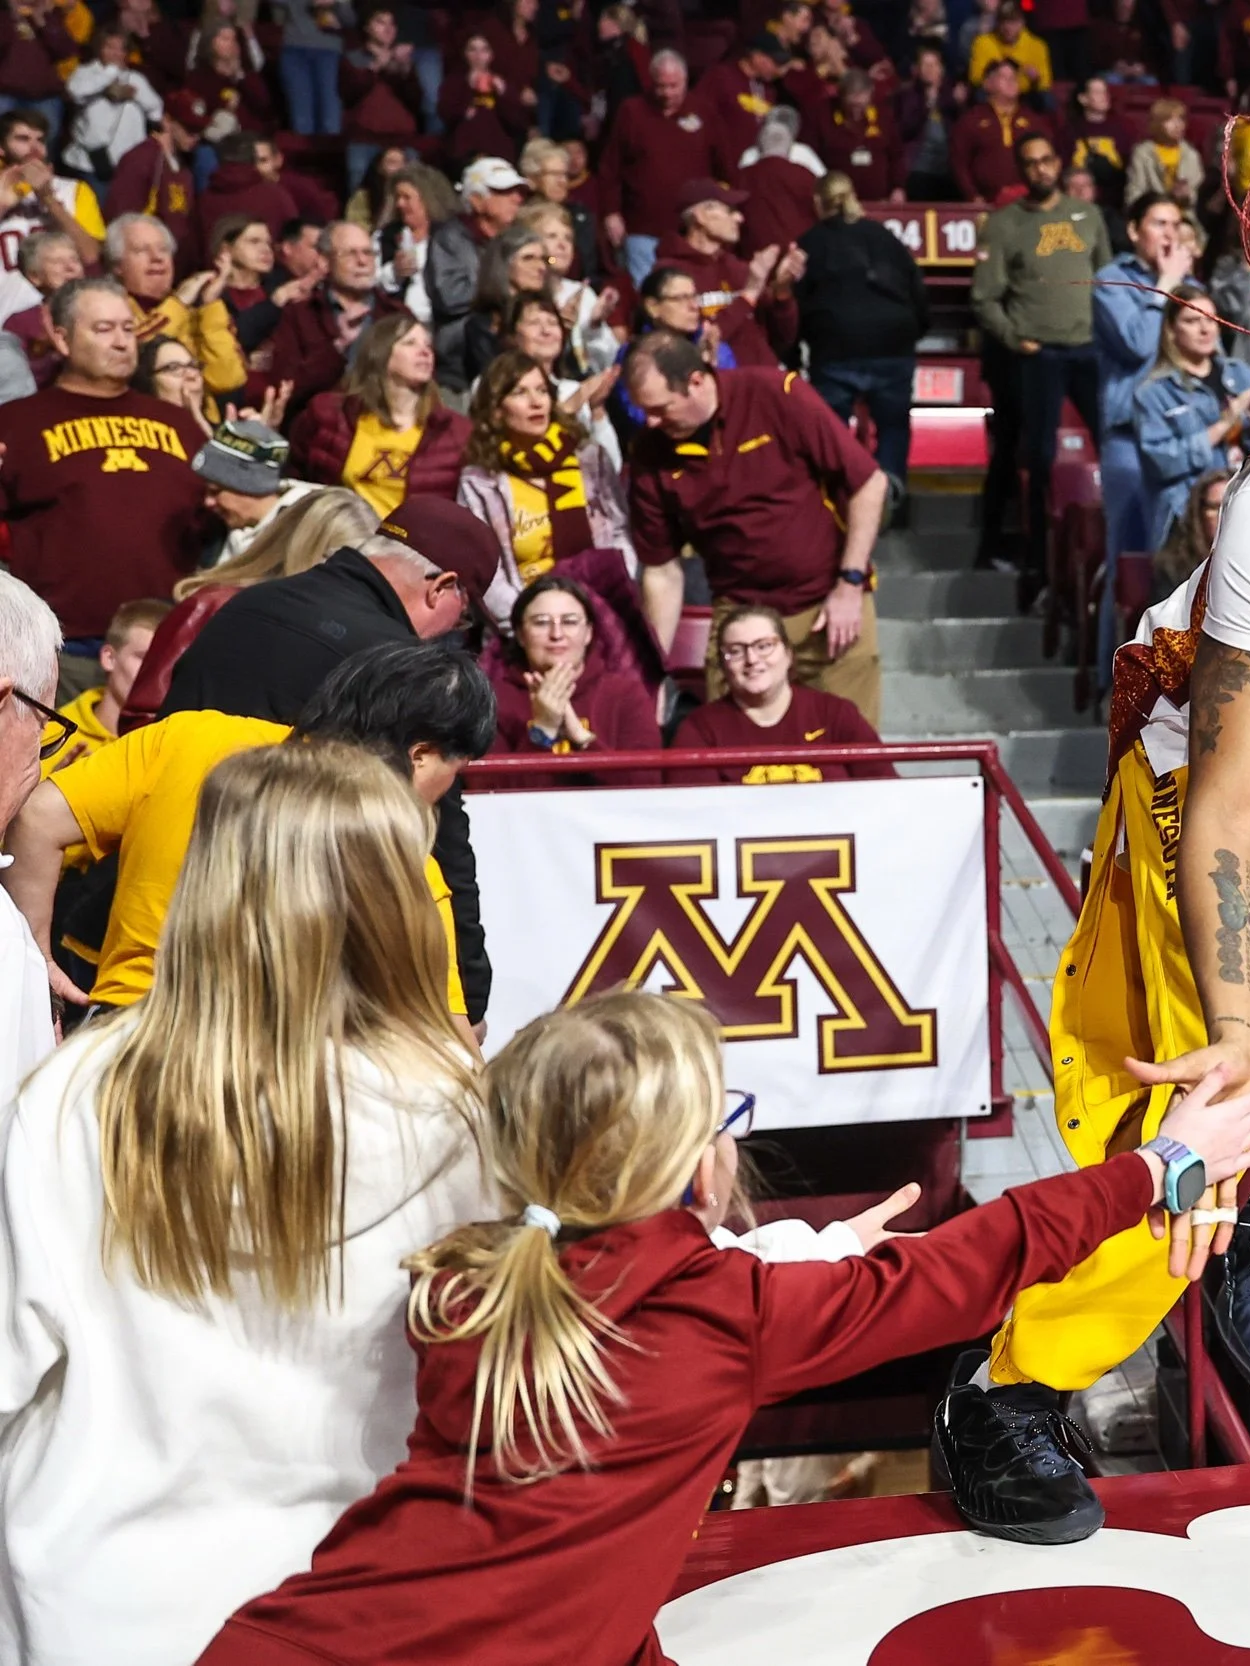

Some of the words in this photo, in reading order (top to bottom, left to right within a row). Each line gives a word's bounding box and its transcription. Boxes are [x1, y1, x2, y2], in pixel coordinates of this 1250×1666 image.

[941, 219, 976, 251] 10
[42, 415, 188, 463] MINNESOTA
[555, 833, 938, 1075] M
